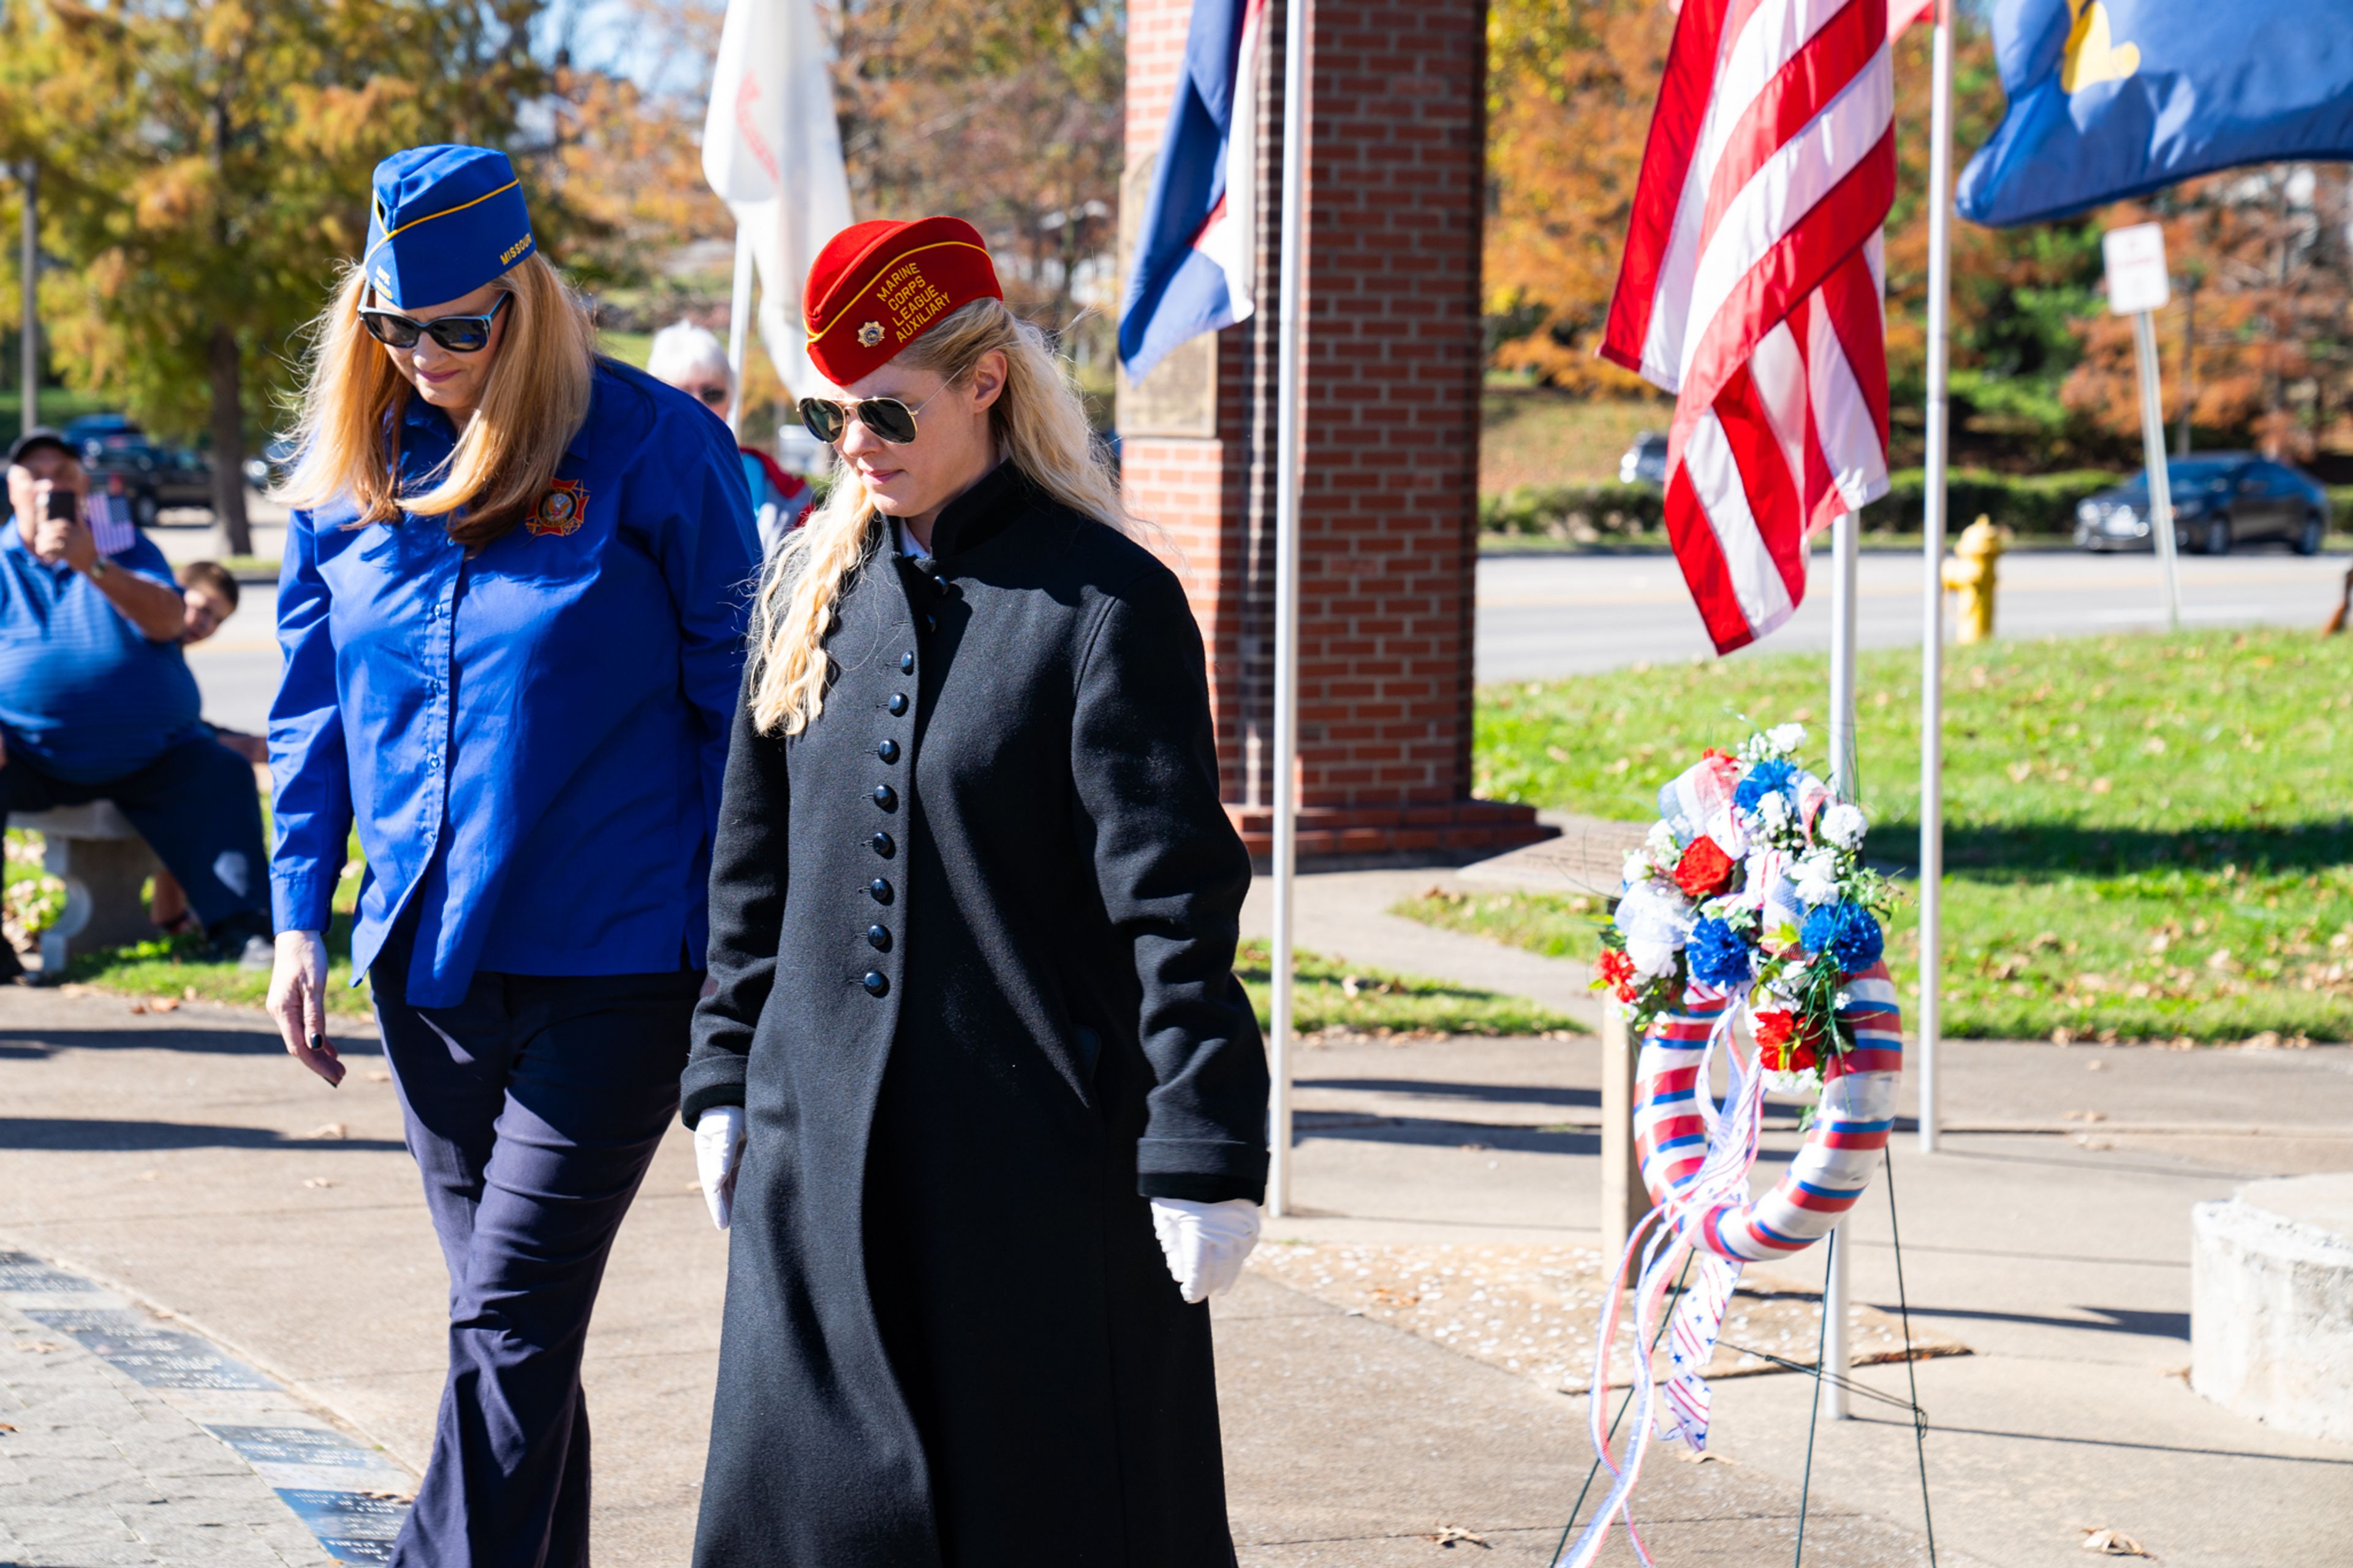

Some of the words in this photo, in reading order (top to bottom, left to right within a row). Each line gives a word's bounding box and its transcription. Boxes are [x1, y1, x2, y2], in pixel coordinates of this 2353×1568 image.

[500, 232, 532, 265] MISSOURI
[876, 262, 920, 301] MARINE
[888, 275, 926, 311] CORPS
[892, 284, 939, 327] LEAGUE
[896, 292, 950, 343] AUXILIARY
